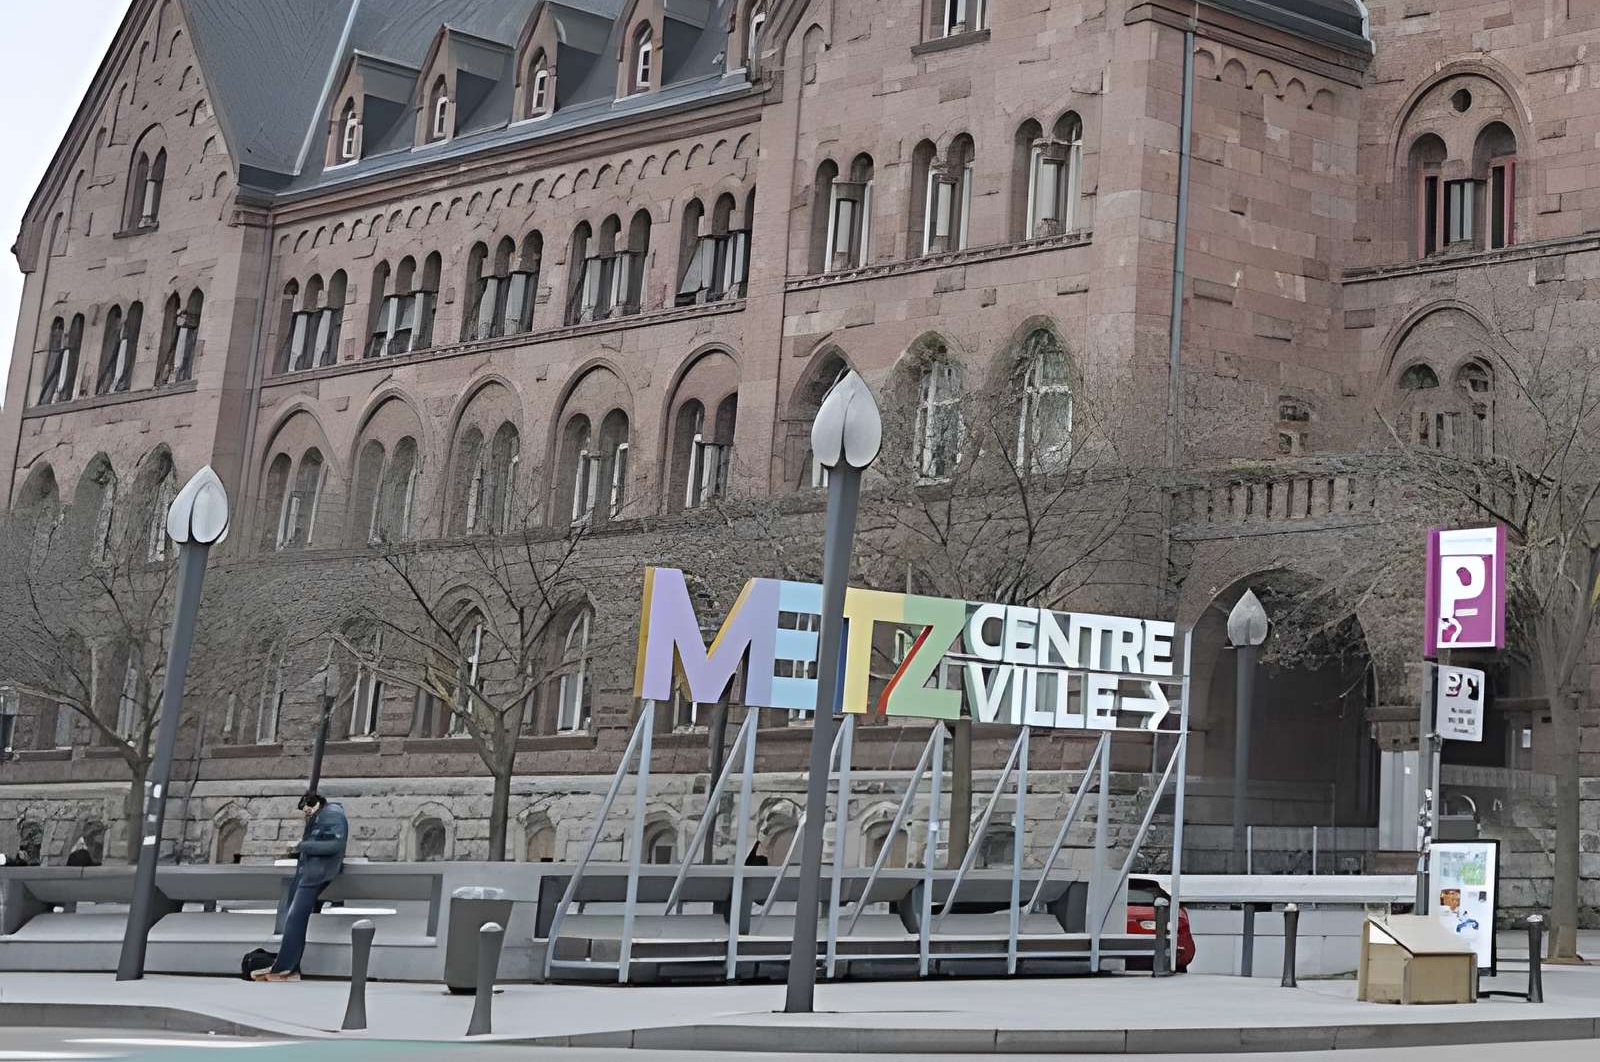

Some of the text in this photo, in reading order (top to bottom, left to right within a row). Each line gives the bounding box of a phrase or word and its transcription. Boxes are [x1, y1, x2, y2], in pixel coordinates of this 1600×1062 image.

[639, 567, 966, 719] METZ
[967, 603, 1175, 675] CENTRE
[966, 662, 1118, 731] VILLE
